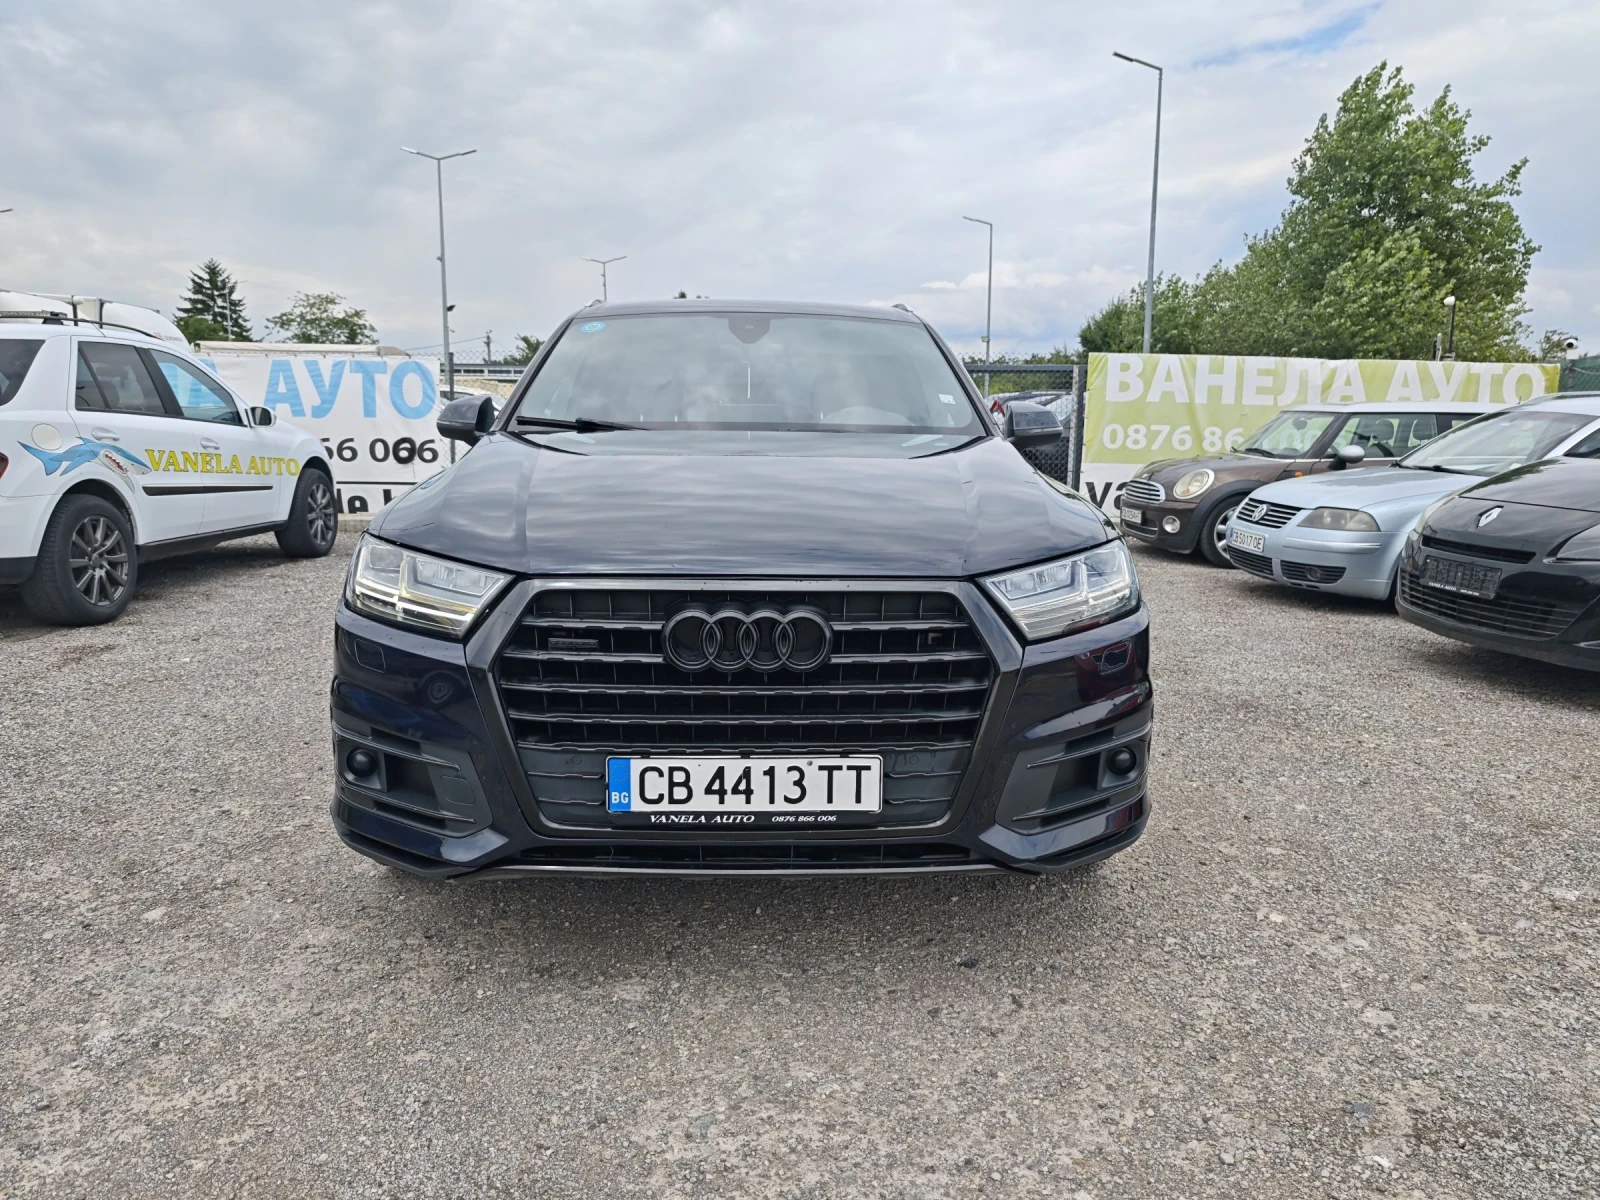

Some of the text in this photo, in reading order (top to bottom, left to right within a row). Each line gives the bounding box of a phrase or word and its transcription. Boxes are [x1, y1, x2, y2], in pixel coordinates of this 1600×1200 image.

[263, 359, 437, 420] АУТО
[1106, 354, 1545, 405] ВАНЕЛА АУТО
[1103, 424, 1192, 450] 0876
[145, 449, 300, 476] VANELA AUTO
[611, 791, 629, 804] BG
[639, 765, 872, 805] CB 4413 TT
[650, 815, 707, 823] VANELA
[711, 815, 755, 823] AUTO
[771, 815, 796, 823] 0876
